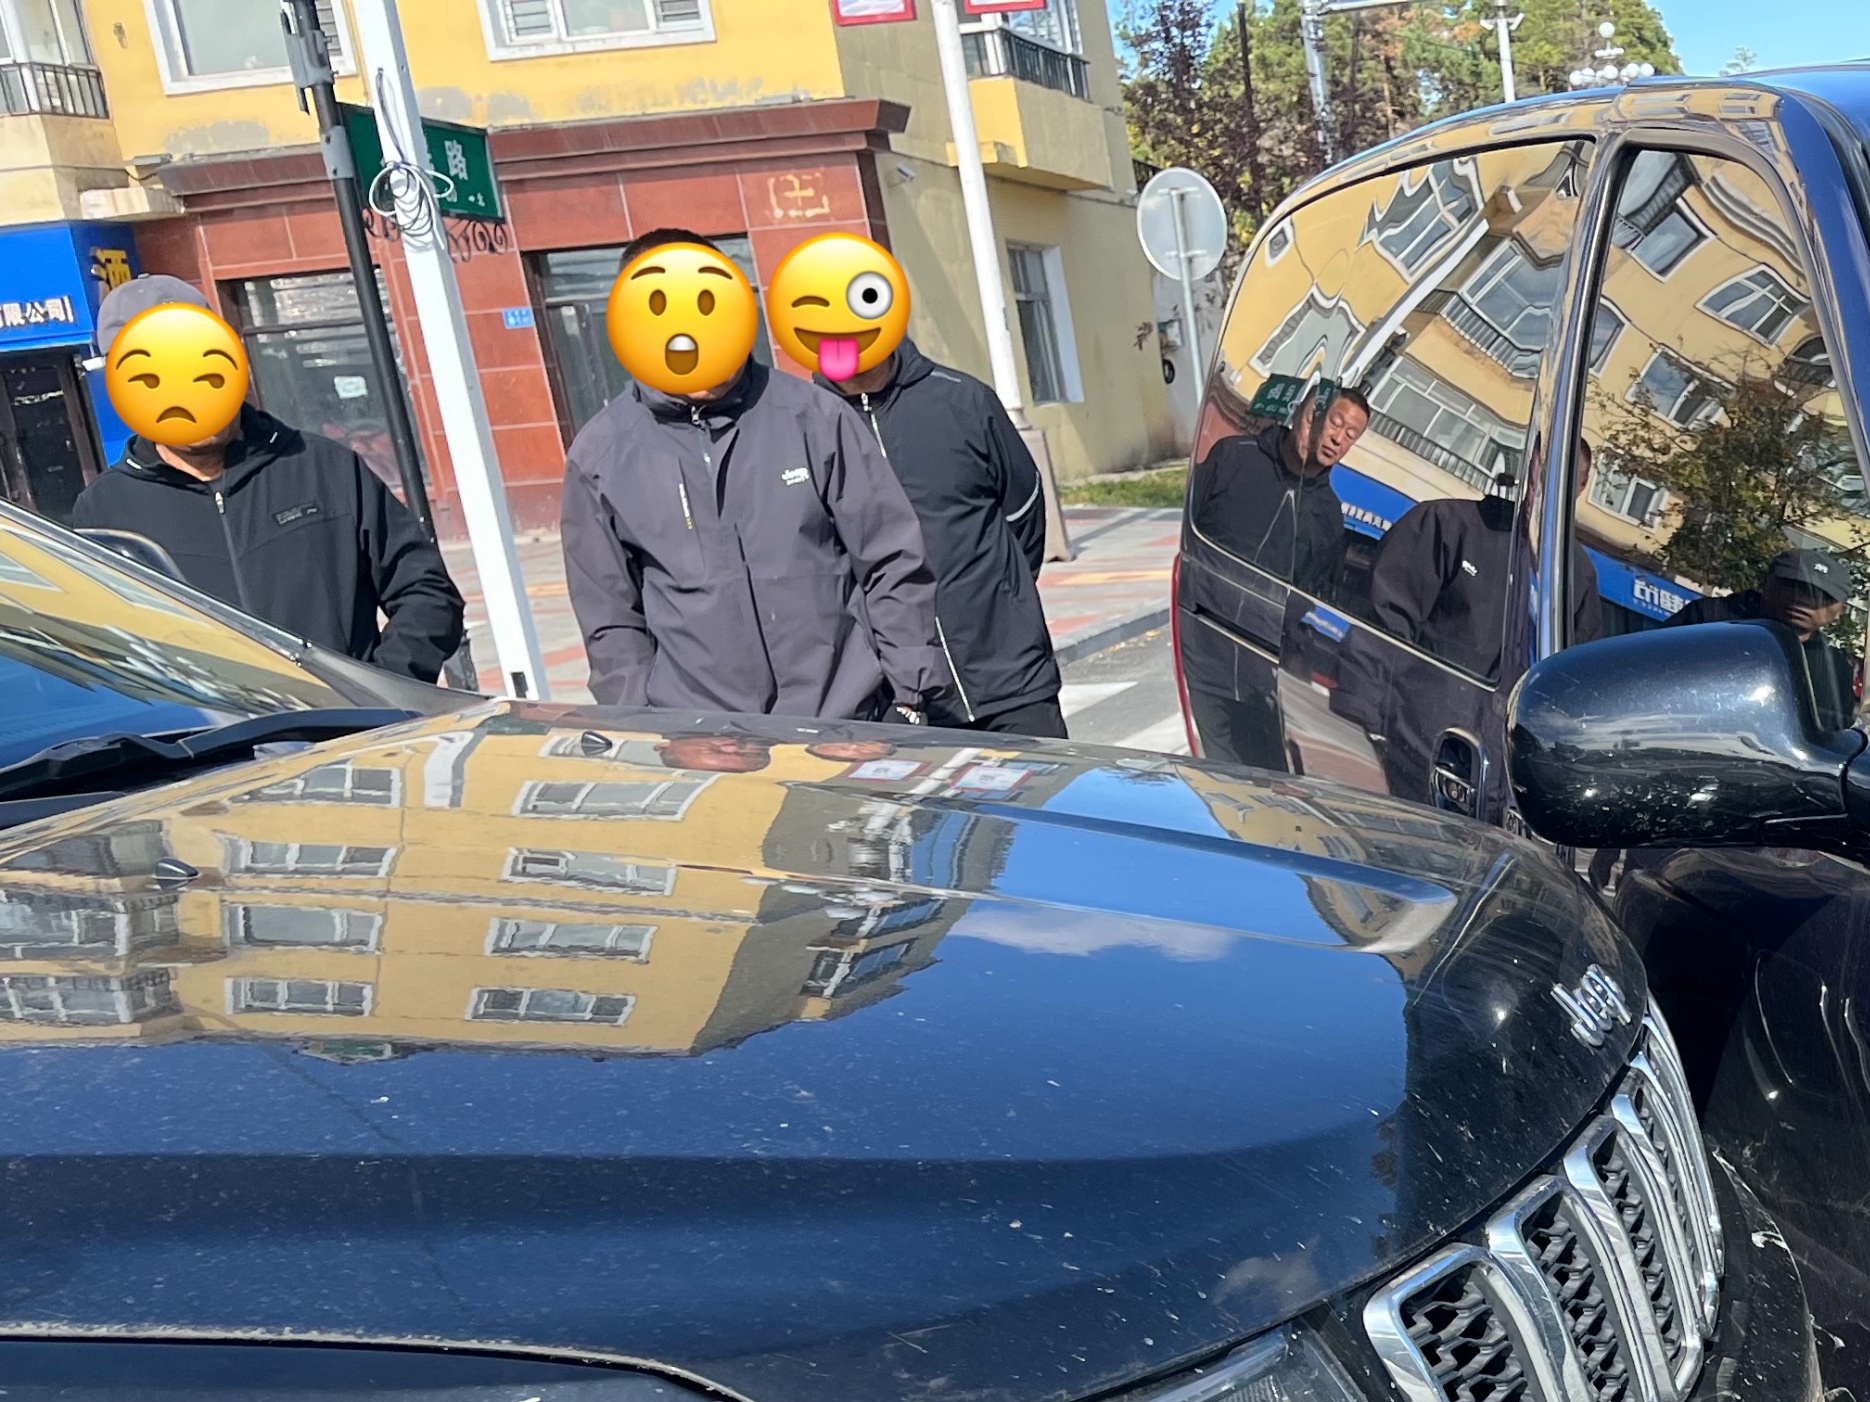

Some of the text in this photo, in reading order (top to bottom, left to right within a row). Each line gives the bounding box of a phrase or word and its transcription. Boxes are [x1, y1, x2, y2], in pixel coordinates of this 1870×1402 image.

[0, 295, 74, 328] 限公司
[1550, 963, 1632, 1047] Jeep
